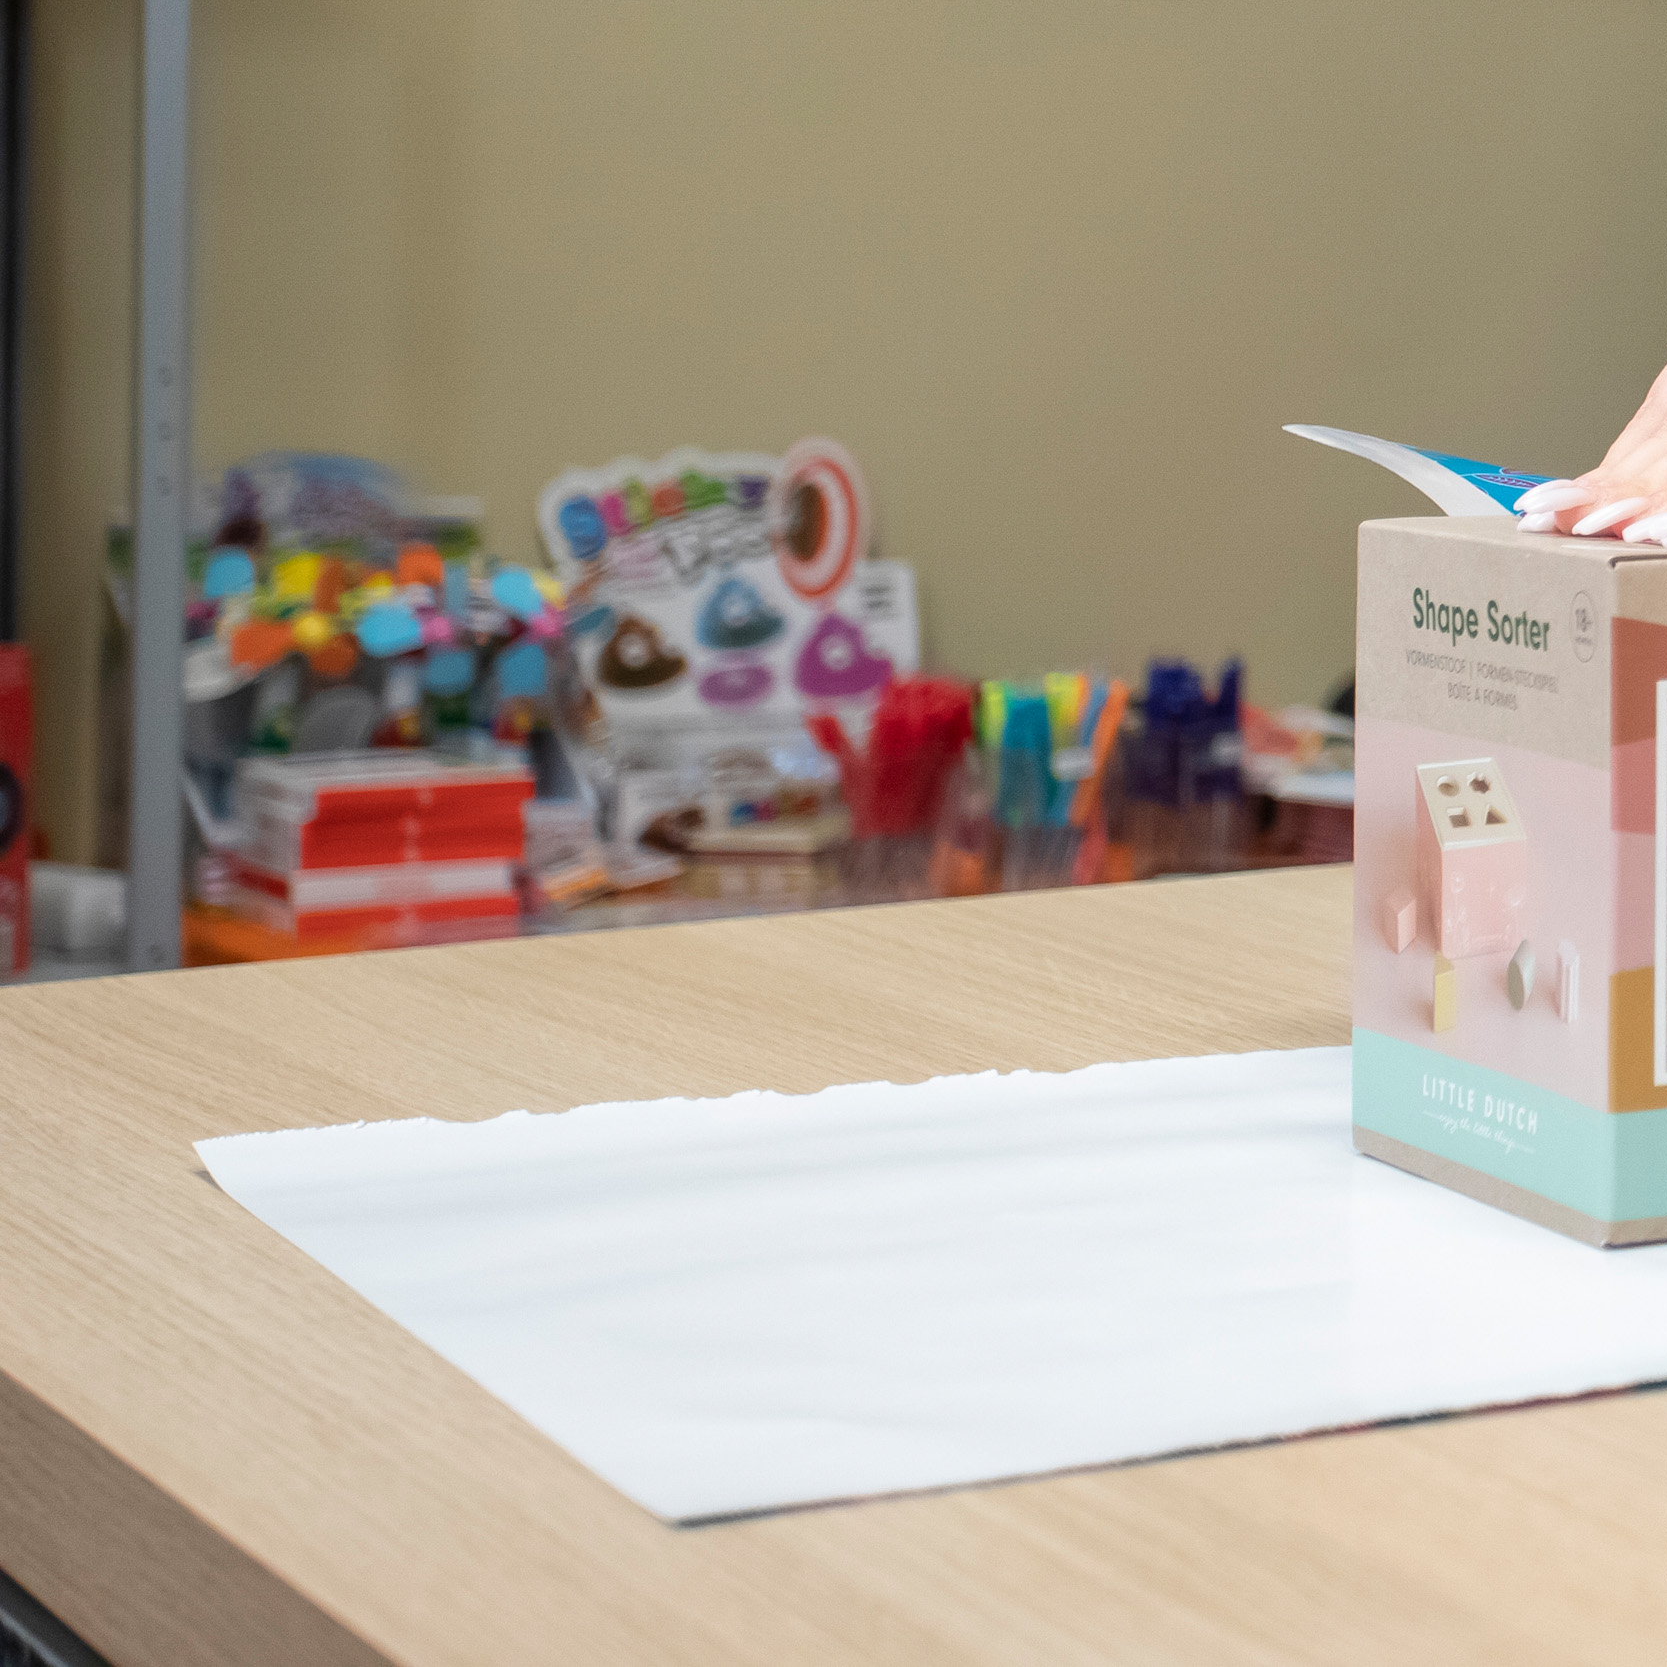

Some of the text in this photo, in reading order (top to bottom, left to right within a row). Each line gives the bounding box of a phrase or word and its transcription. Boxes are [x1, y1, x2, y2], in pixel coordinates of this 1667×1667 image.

[1413, 587, 1550, 651] Shape Sorter
[1423, 1074, 1538, 1135] LITTLE DUTCH
